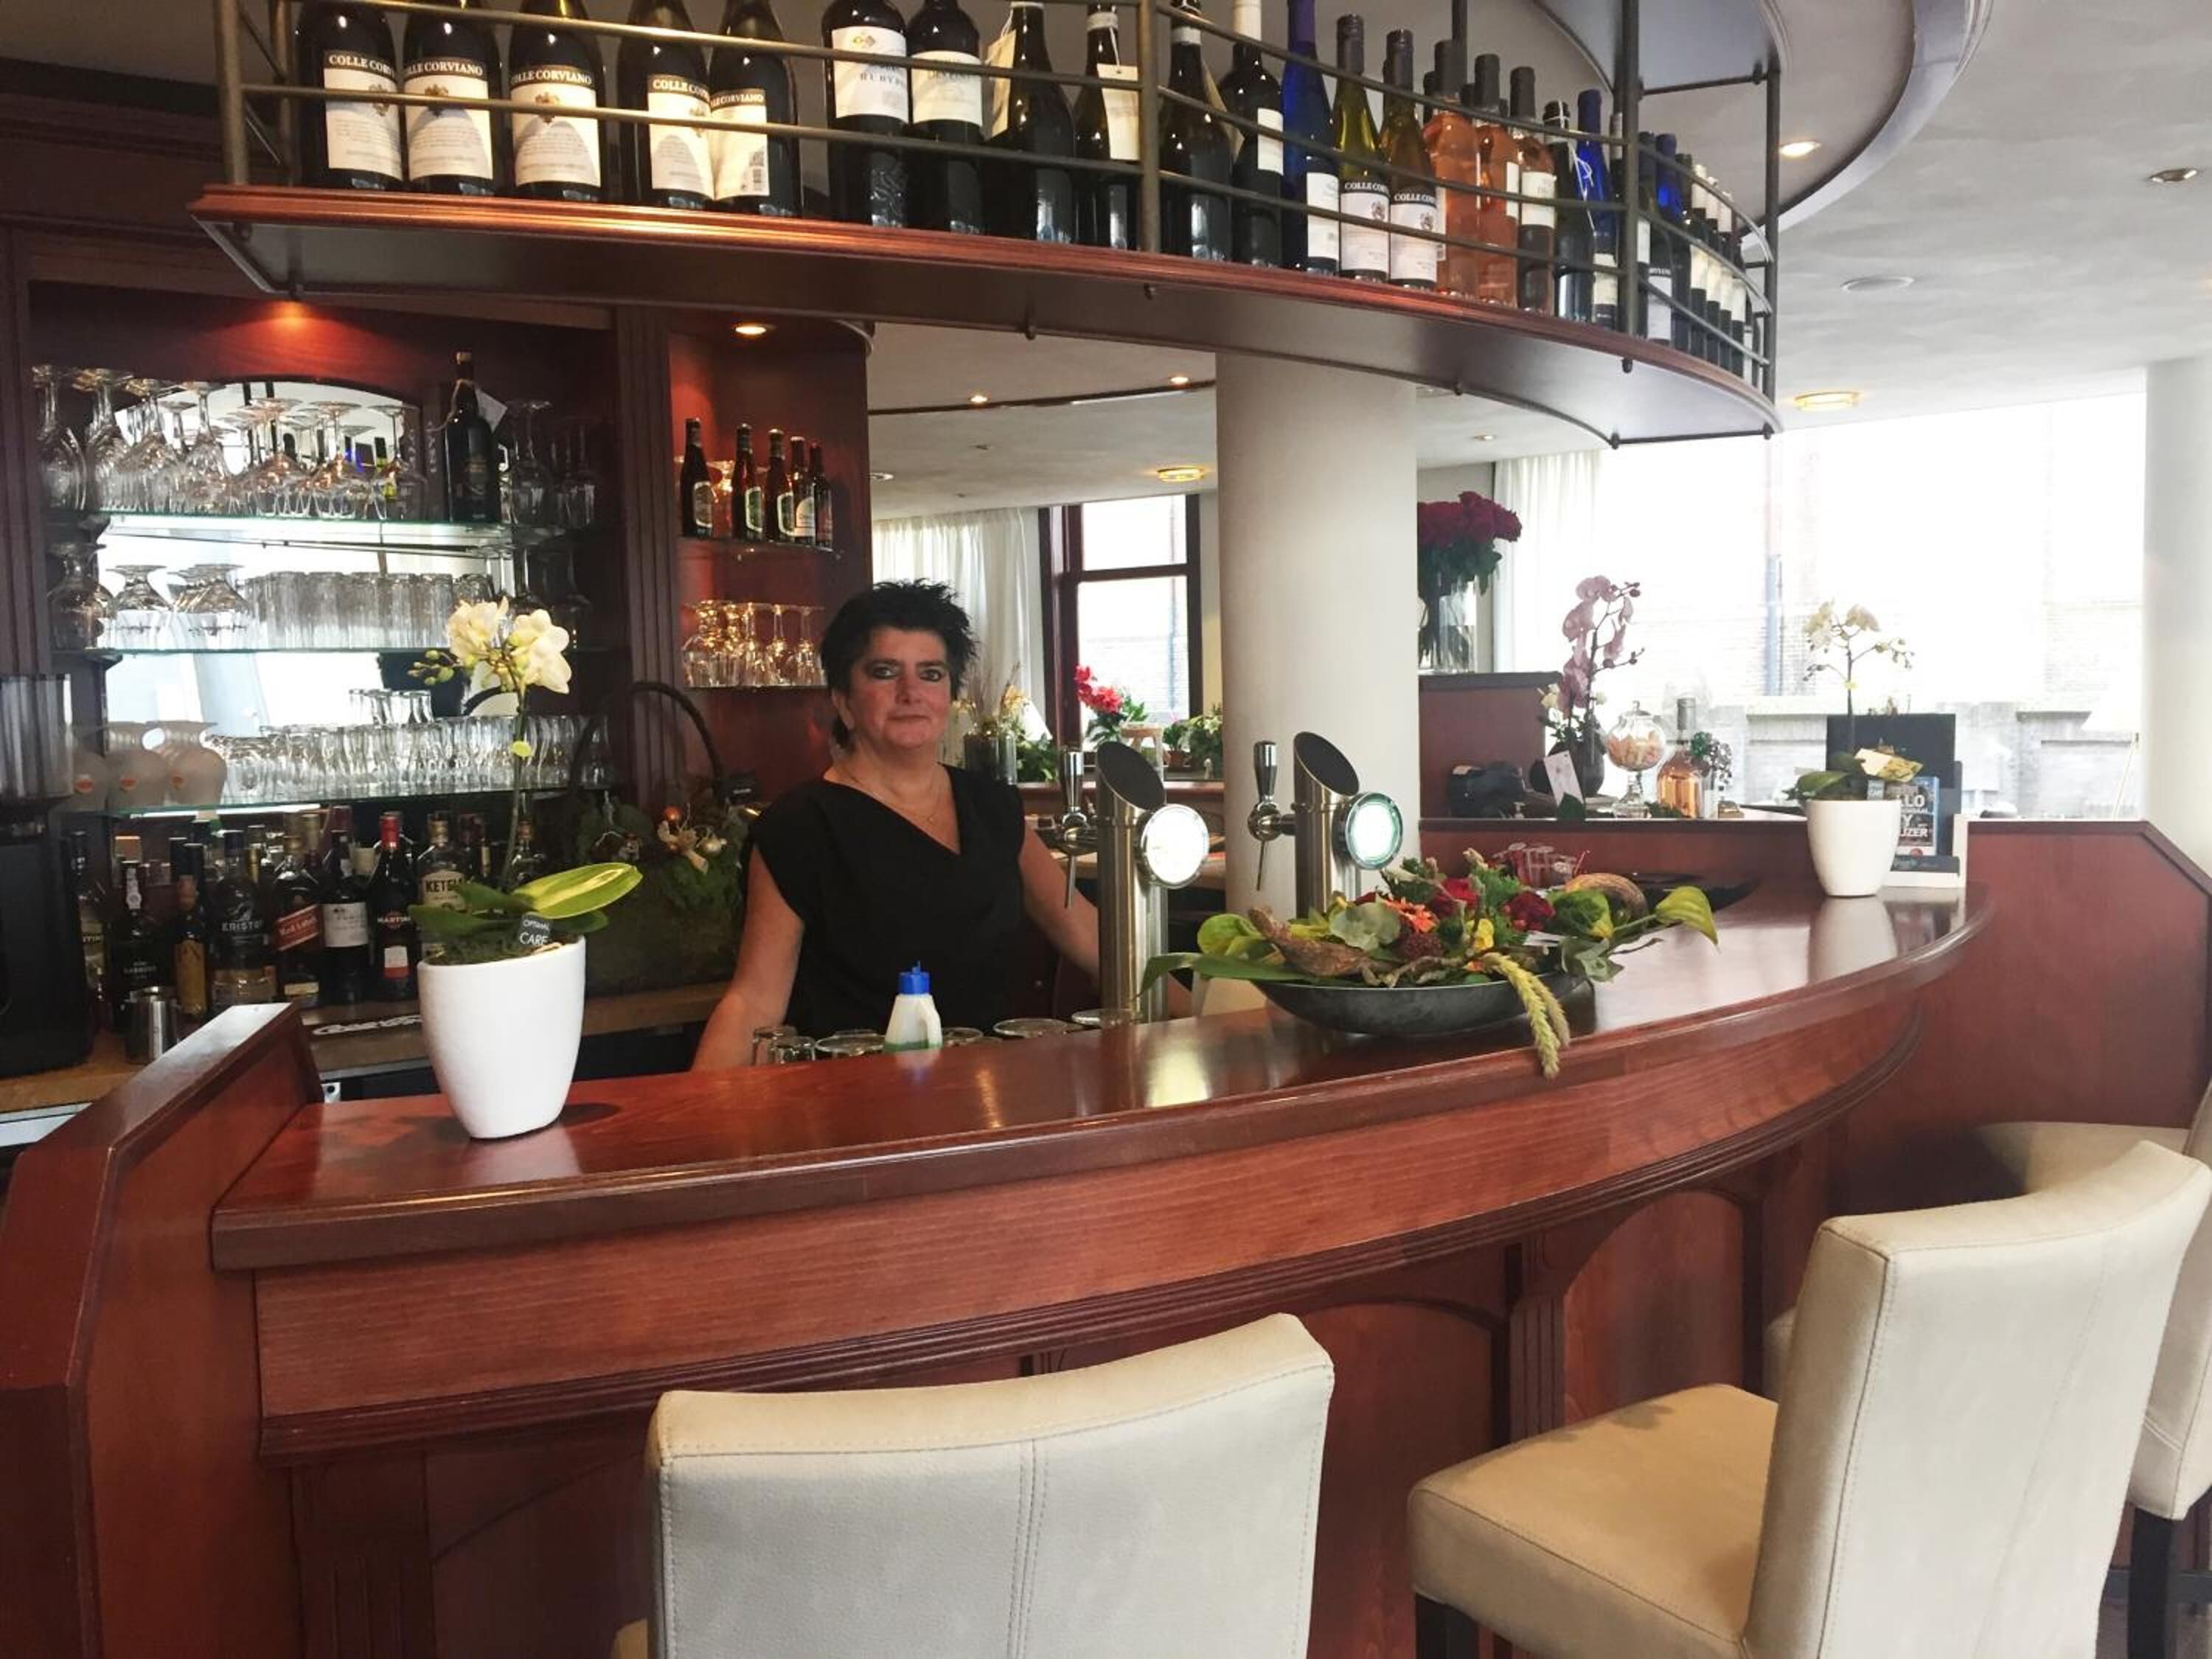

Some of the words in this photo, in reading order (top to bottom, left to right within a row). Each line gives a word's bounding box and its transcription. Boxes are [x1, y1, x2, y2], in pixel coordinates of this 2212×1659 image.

[329, 54, 368, 69] COLLE
[424, 61, 484, 77] CORVIANO
[536, 69, 592, 85] CORVIANO
[652, 79, 688, 92] COLLE
[720, 94, 764, 104] CORVIANO
[1344, 182, 1372, 190] COLLE
[1394, 193, 1422, 201] COLLE
[519, 931, 551, 945] CARE
